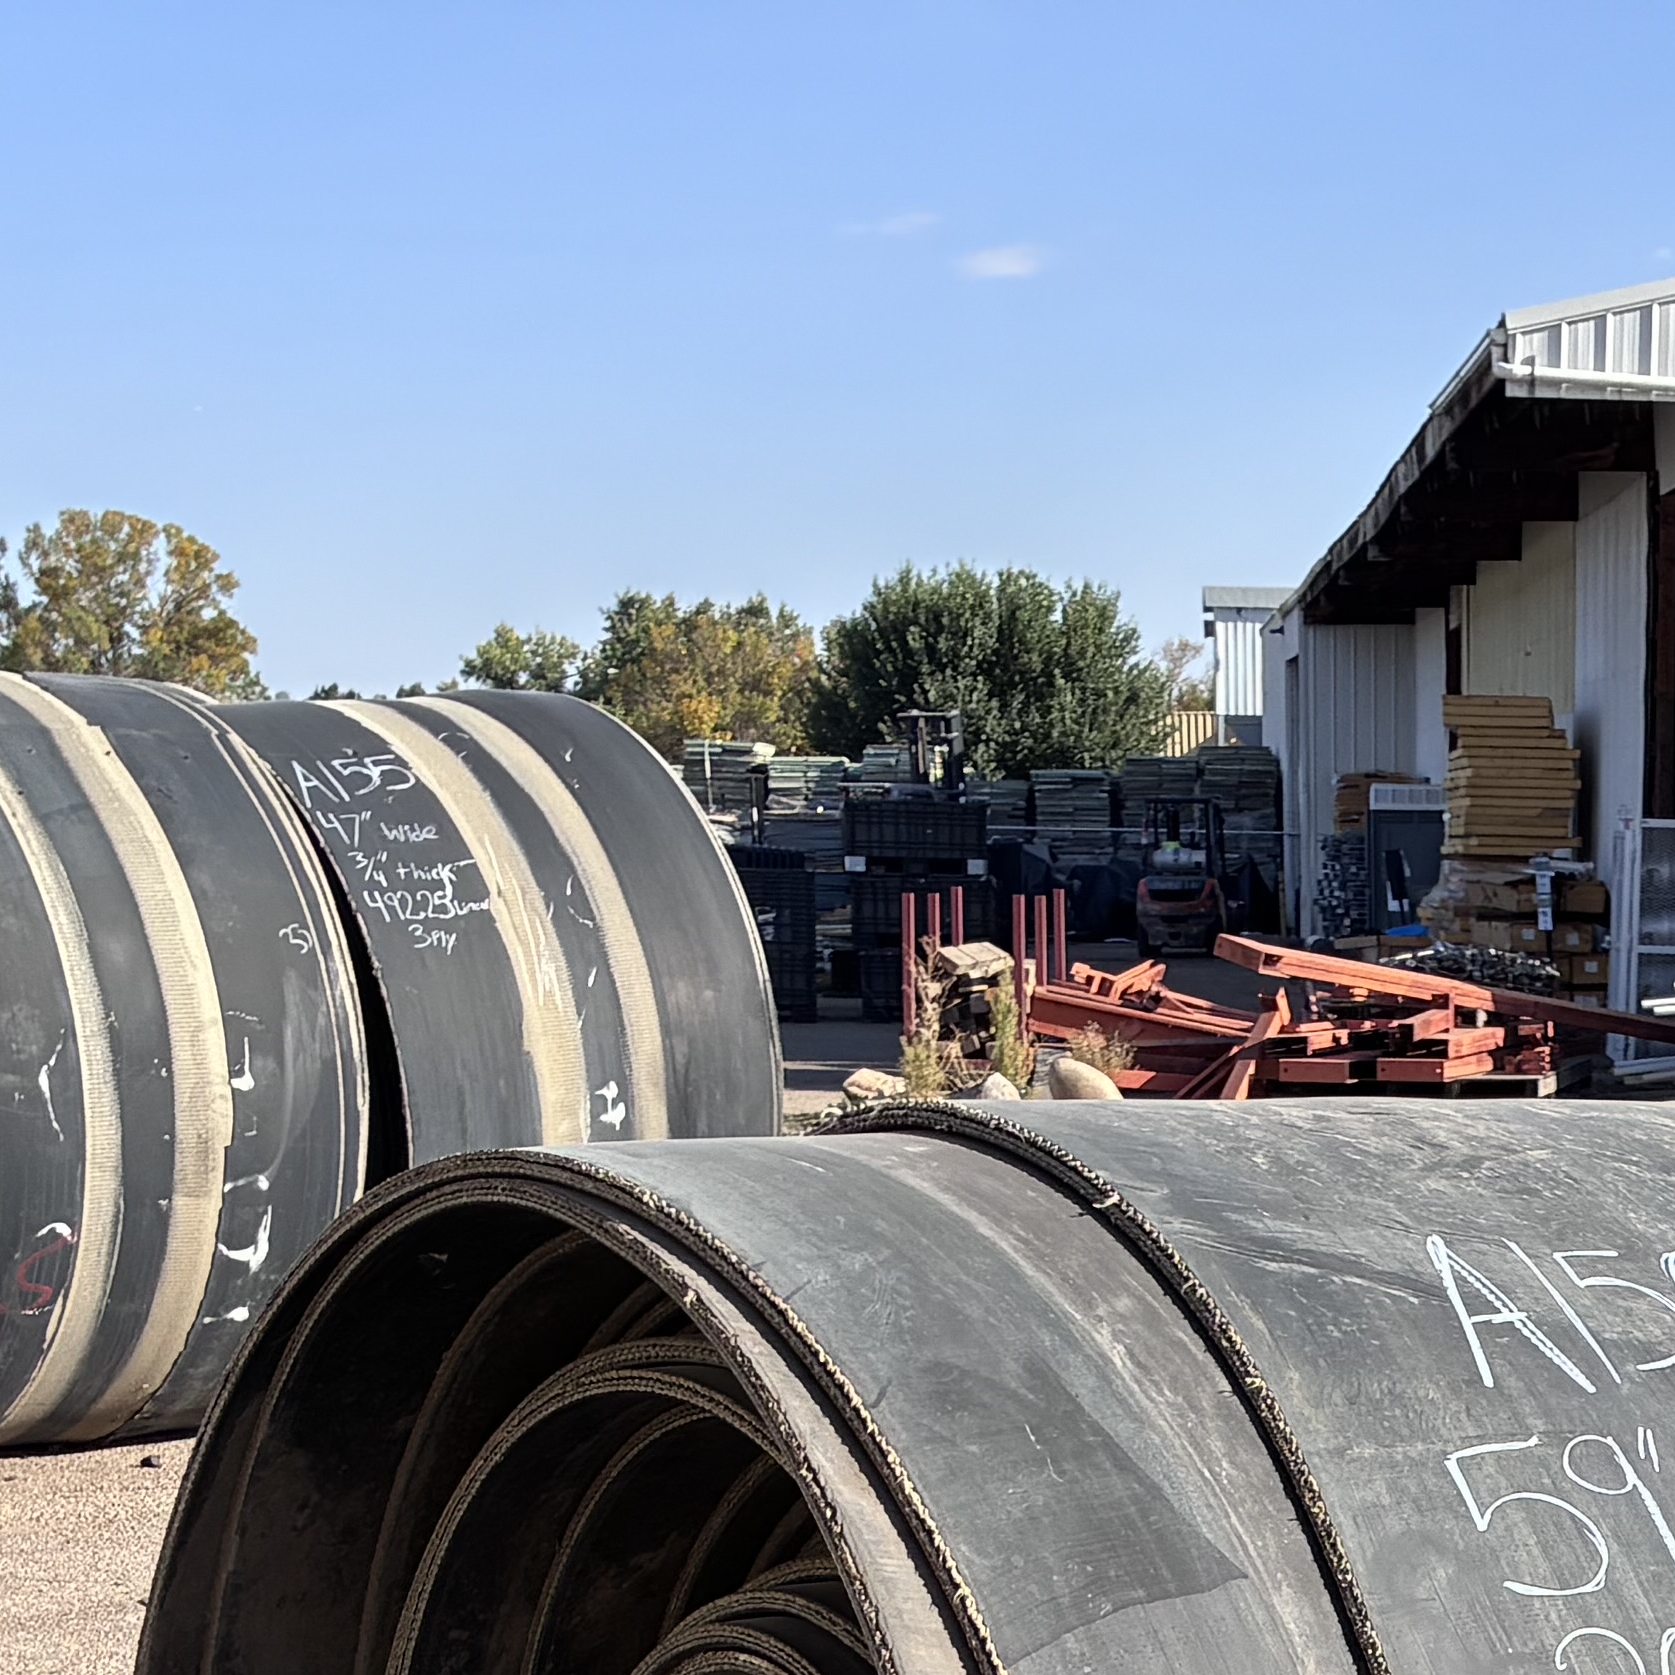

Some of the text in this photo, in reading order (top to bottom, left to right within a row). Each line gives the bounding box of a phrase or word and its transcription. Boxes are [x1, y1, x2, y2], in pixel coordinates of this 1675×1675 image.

[291, 754, 416, 808] A155
[316, 810, 372, 848] 47"
[408, 923, 432, 949] 3
